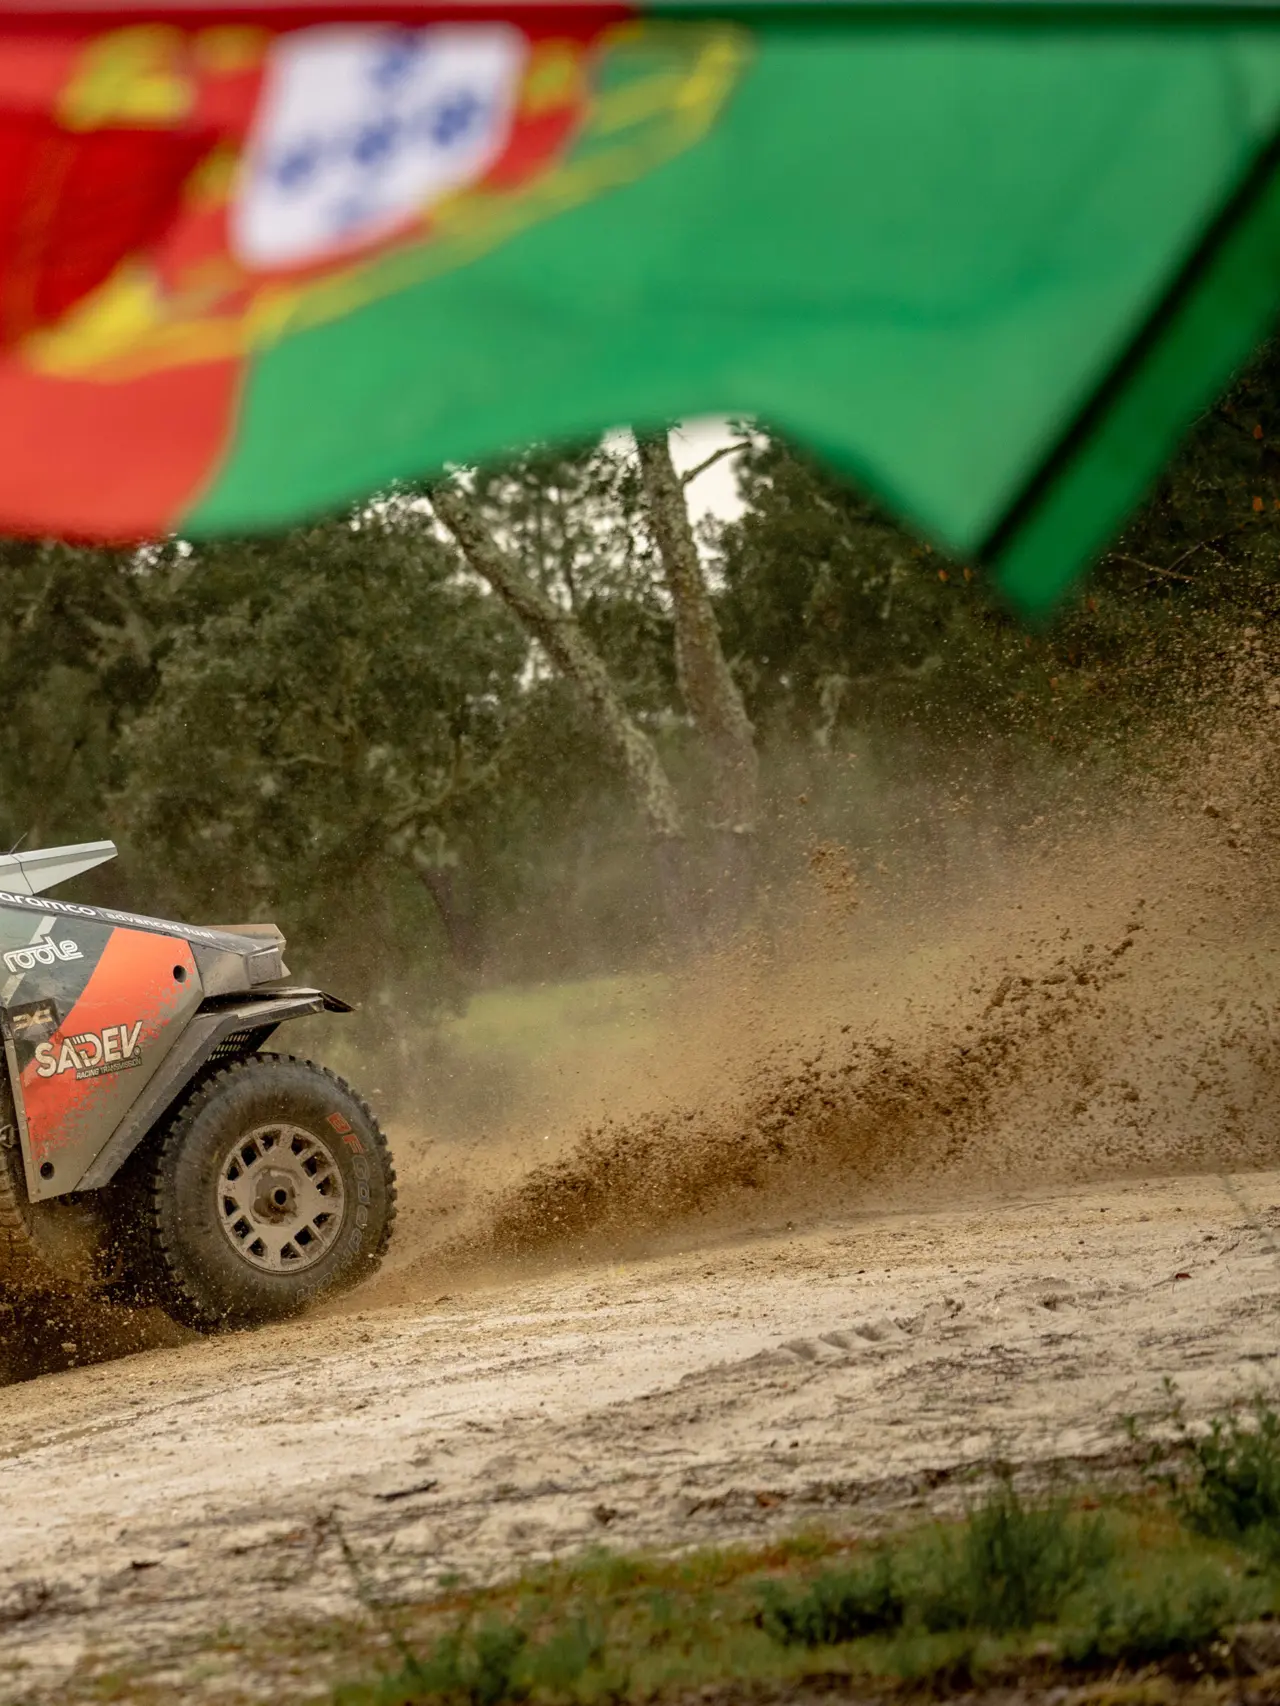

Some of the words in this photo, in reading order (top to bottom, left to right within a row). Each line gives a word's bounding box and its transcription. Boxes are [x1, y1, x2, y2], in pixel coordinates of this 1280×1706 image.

[105, 911, 183, 933] advanced
[184, 925, 216, 940] fuel
[35, 1021, 142, 1078] SADEV
[76, 1068, 100, 1080] RACING
[100, 1057, 142, 1074] TRANSMISSION
